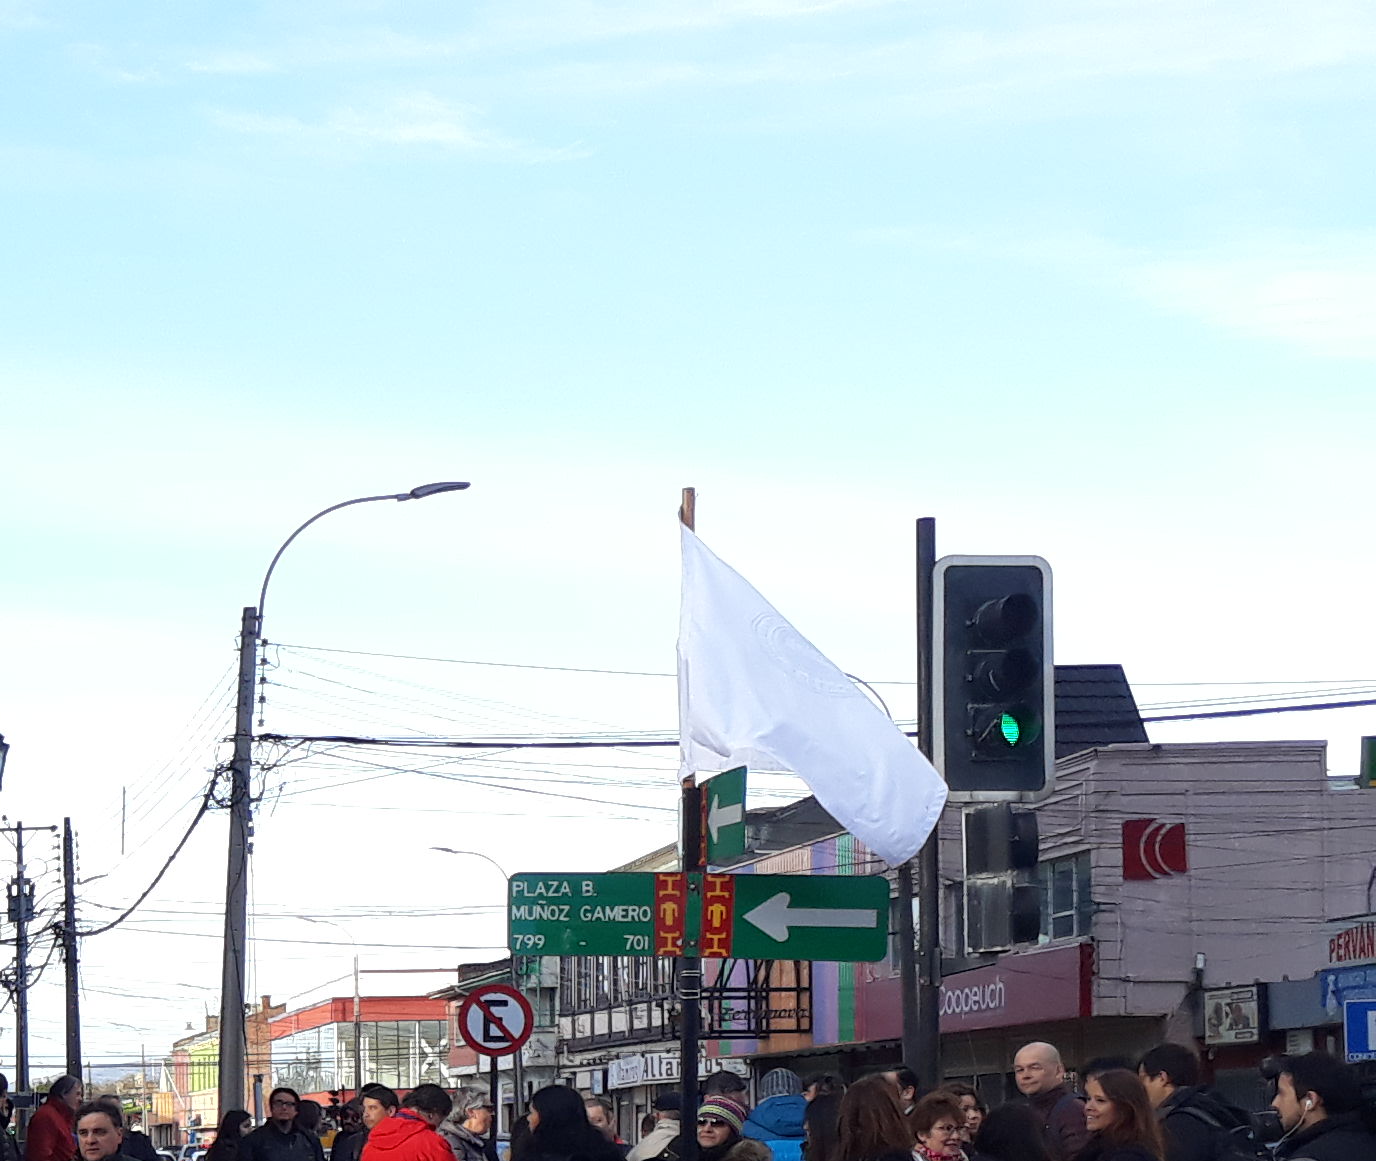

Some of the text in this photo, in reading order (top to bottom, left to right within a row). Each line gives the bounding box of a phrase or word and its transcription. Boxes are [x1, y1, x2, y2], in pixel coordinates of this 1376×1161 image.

[511, 880, 598, 897] PLAZA B.
[510, 900, 652, 923] MUÑOZ GAMERO
[512, 934, 546, 951] 799
[623, 934, 650, 951] 701
[938, 974, 1006, 1020] Coopeuch
